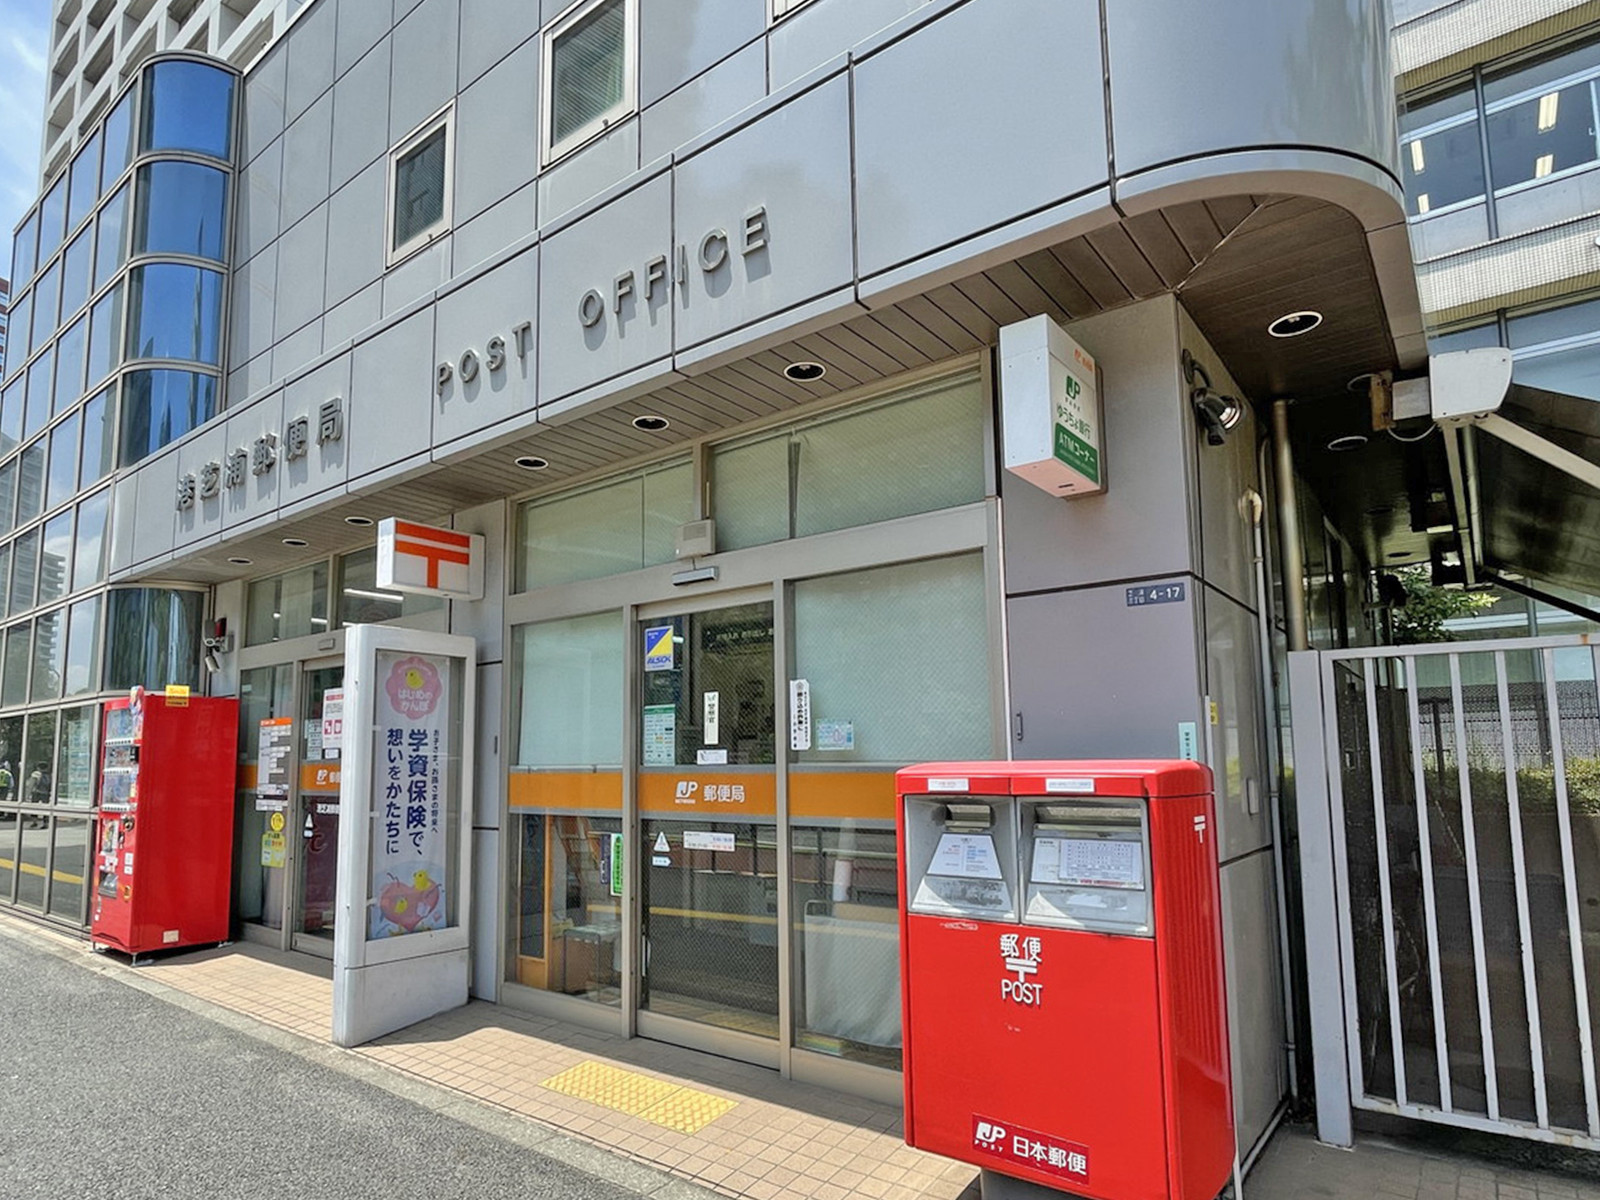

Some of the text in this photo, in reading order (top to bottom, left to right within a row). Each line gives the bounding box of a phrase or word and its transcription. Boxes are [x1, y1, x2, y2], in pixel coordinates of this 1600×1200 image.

[436, 206, 767, 396] POST OFFICE
[1059, 429, 1096, 463] ATMコーナー
[1150, 586, 1180, 600] 4-17
[385, 727, 404, 855] 想いをかたちに
[406, 728, 428, 856] 学資保険で、
[675, 781, 745, 803] JP 郵便局
[1000, 933, 1042, 963] 郵便
[1001, 978, 1043, 1006] POST
[975, 1121, 1087, 1176] JP 日本郵便
